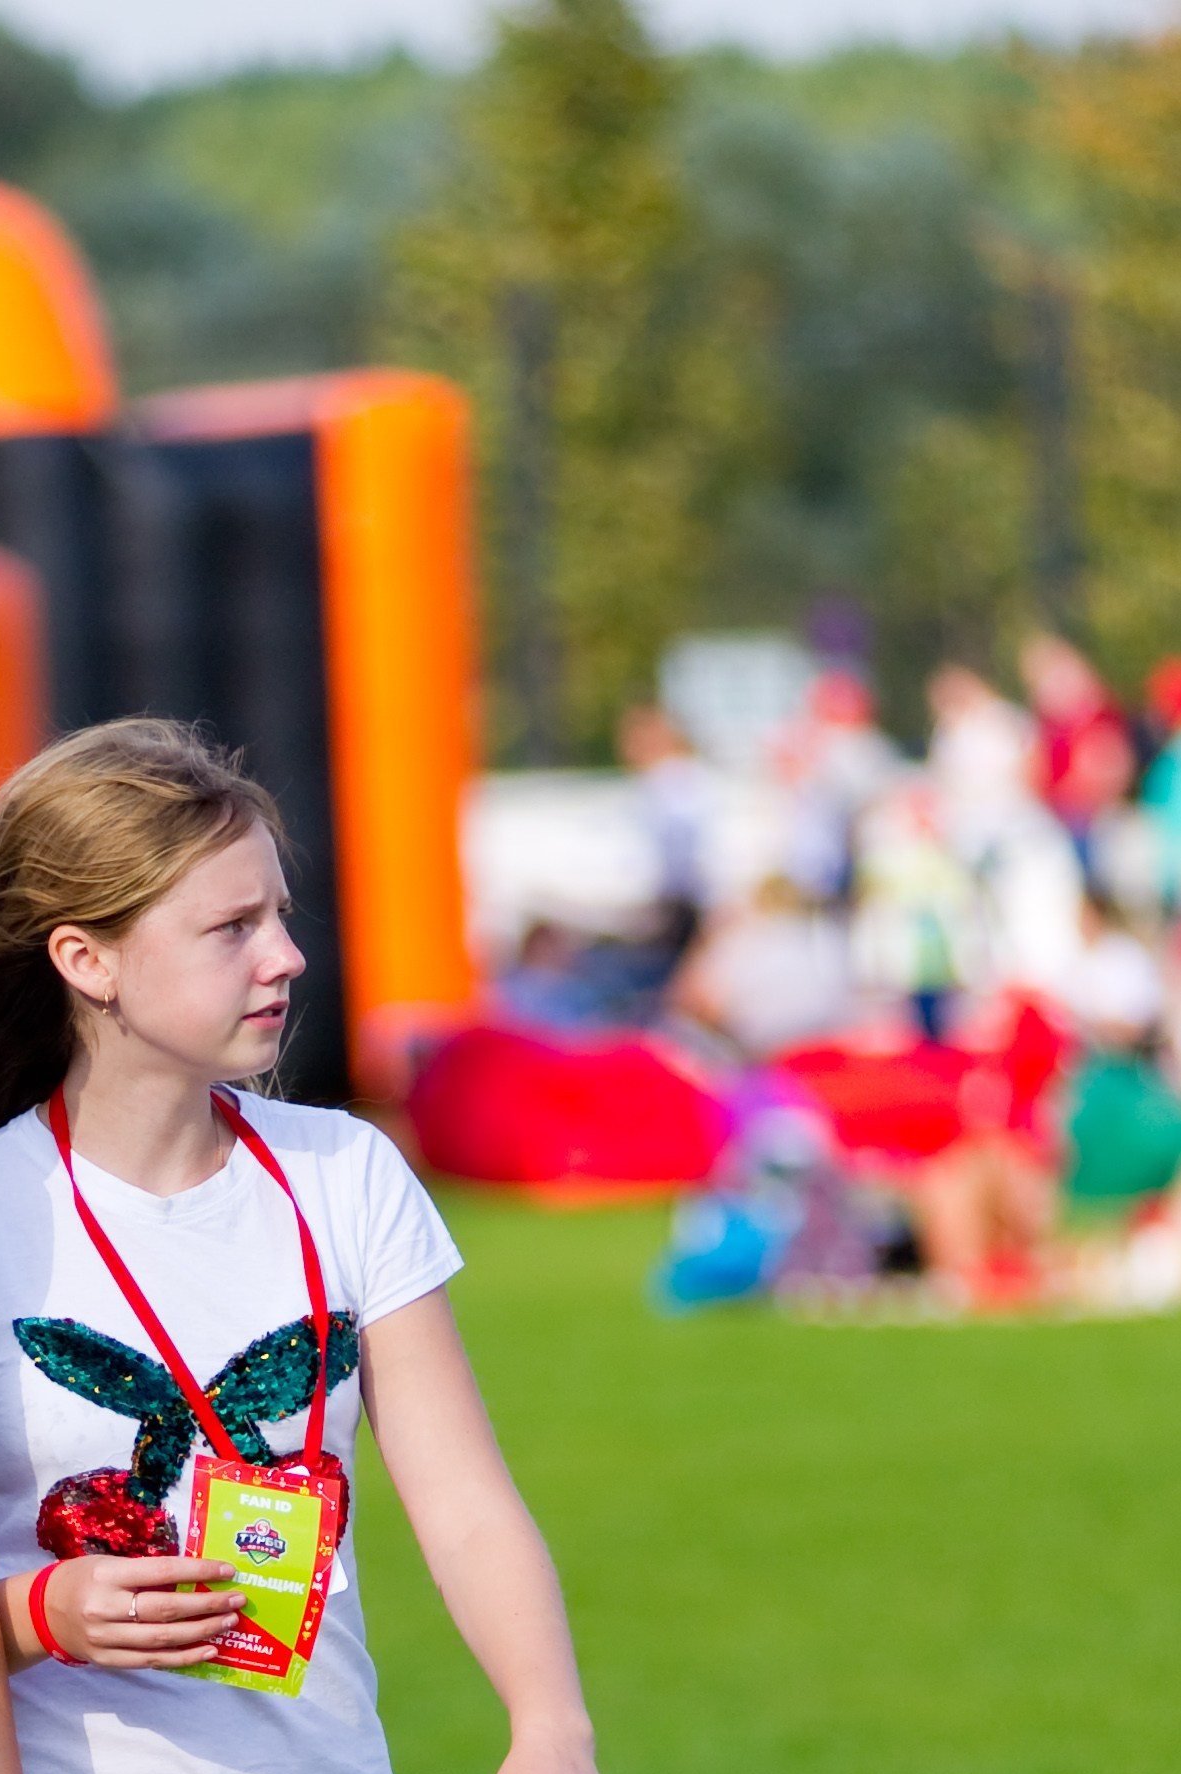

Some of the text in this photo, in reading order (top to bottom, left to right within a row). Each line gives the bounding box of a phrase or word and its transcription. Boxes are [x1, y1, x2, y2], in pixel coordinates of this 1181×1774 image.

[240, 1493, 292, 1512] FAN ID
[240, 1533, 283, 1549] ТУРБО
[232, 1571, 305, 1595] ЕЛЬЩИК
[225, 1639, 273, 1655] СТРАНА!
